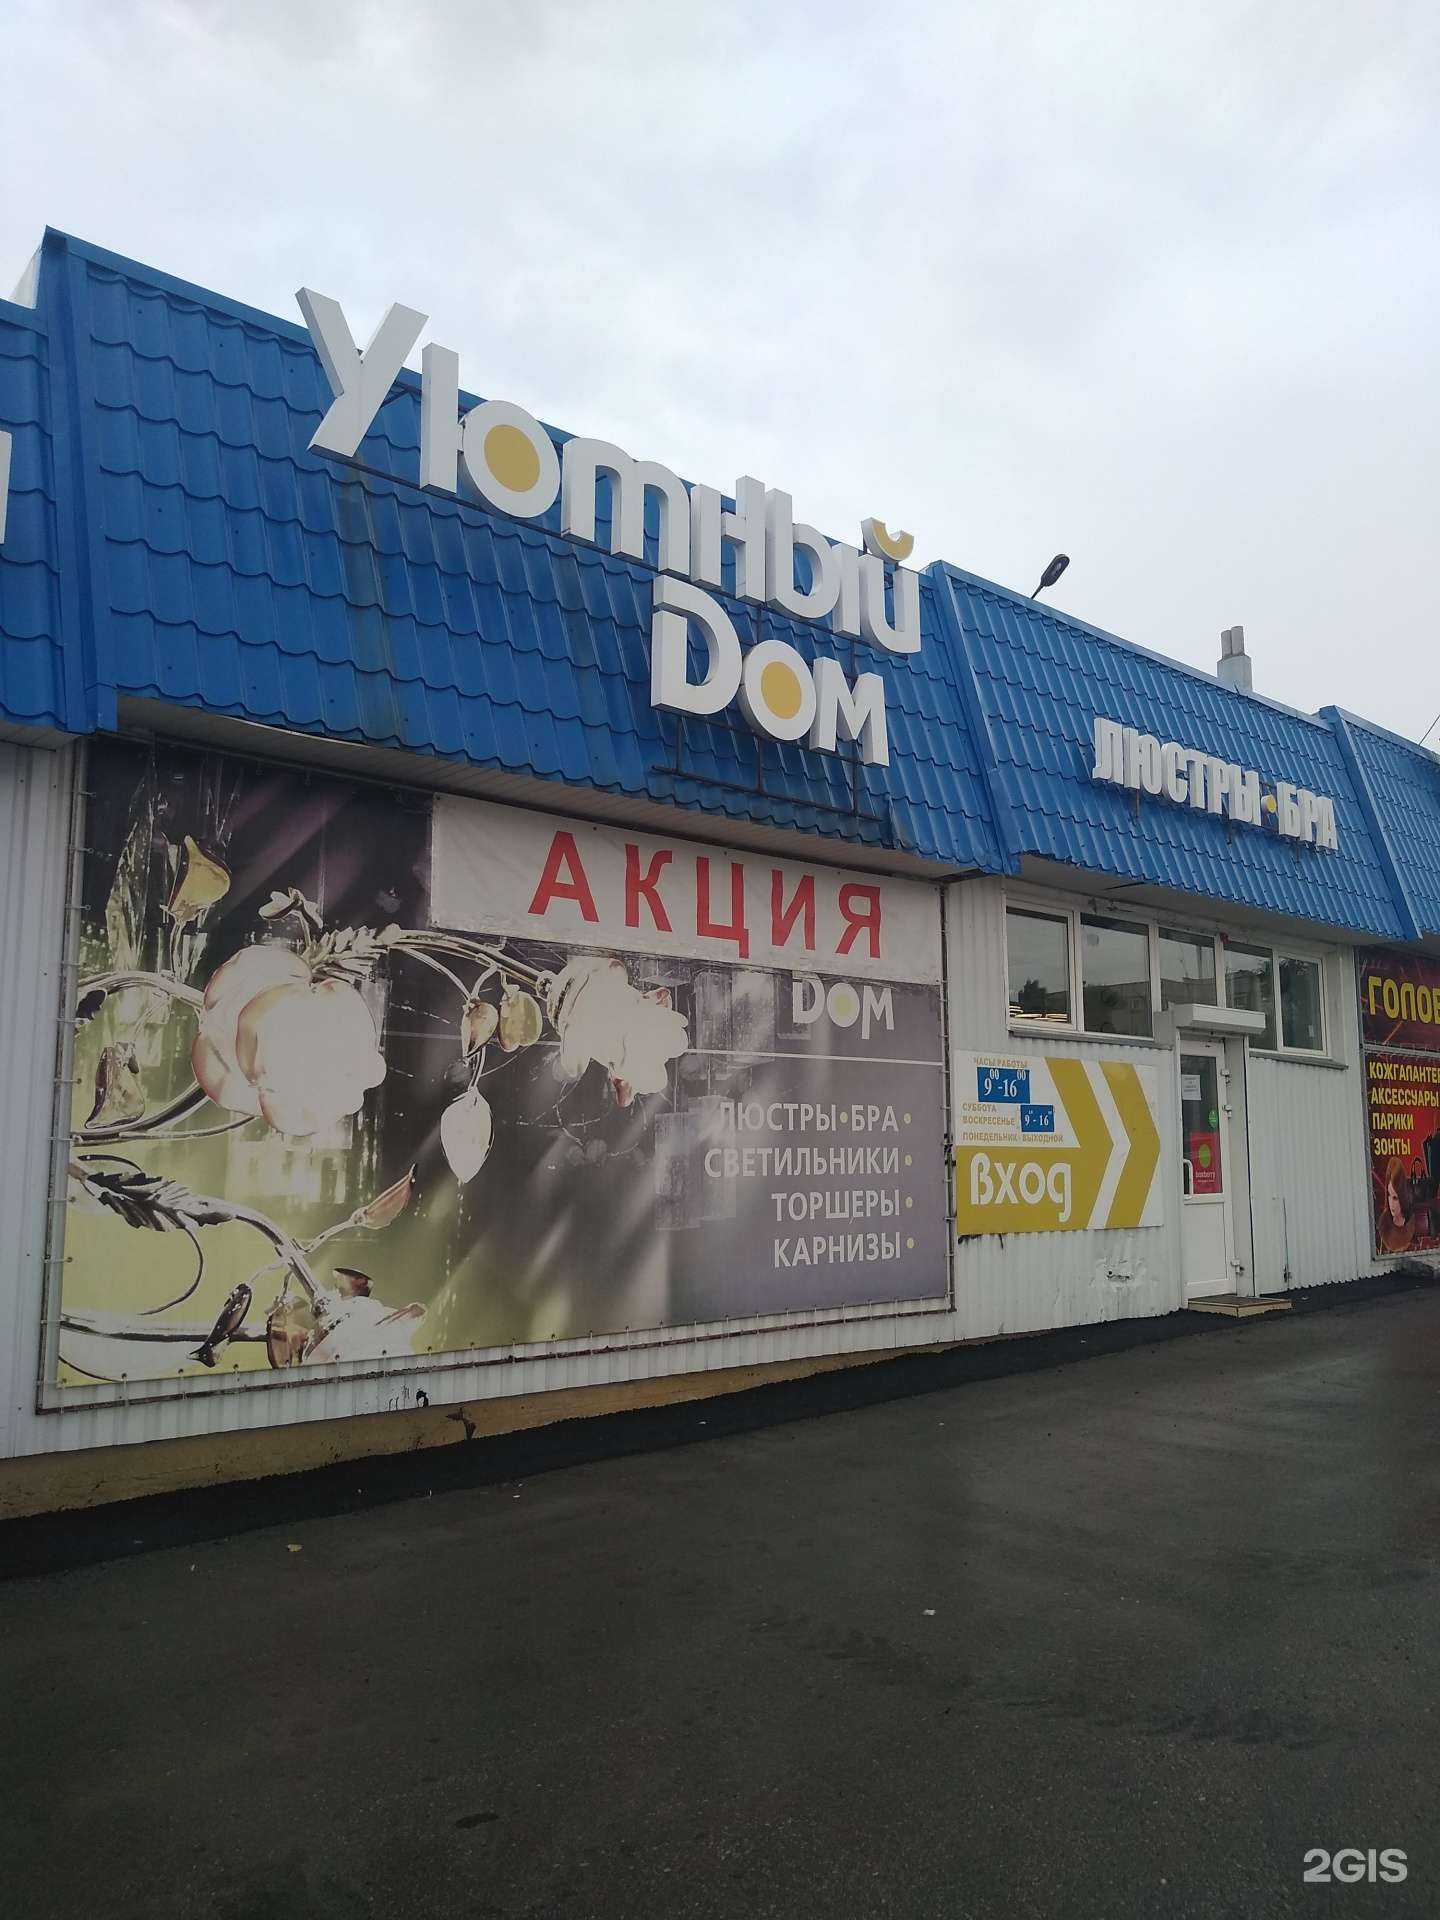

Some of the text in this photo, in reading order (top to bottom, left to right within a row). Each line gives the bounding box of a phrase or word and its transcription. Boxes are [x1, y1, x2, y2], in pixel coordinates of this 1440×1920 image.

[1092, 717, 1338, 850] ЛЮСТРЫ БРА
[527, 830, 882, 959] АКЦИЯ
[1369, 1062, 1440, 1084] КОЖГАЛАНТЕ
[962, 1103, 997, 1113] СУББОТА
[1371, 1087, 1440, 1107] АКСЕССУАРЫ
[719, 1102, 899, 1132] ЛЮСТРЫ БРА
[962, 1115, 1016, 1126] ВОСКРЕСЕНЬЕ
[1372, 1112, 1414, 1130] ПАРИКИ
[962, 1132, 1018, 1143] ПОНЕДЕЛЬНИК
[1374, 1137, 1411, 1156] ЗОНТЫ
[704, 1146, 900, 1178] СВЕТИЛЬНИКИ
[969, 1152, 1072, 1223] Вход
[773, 1231, 901, 1268] КАРНИЗЫ
